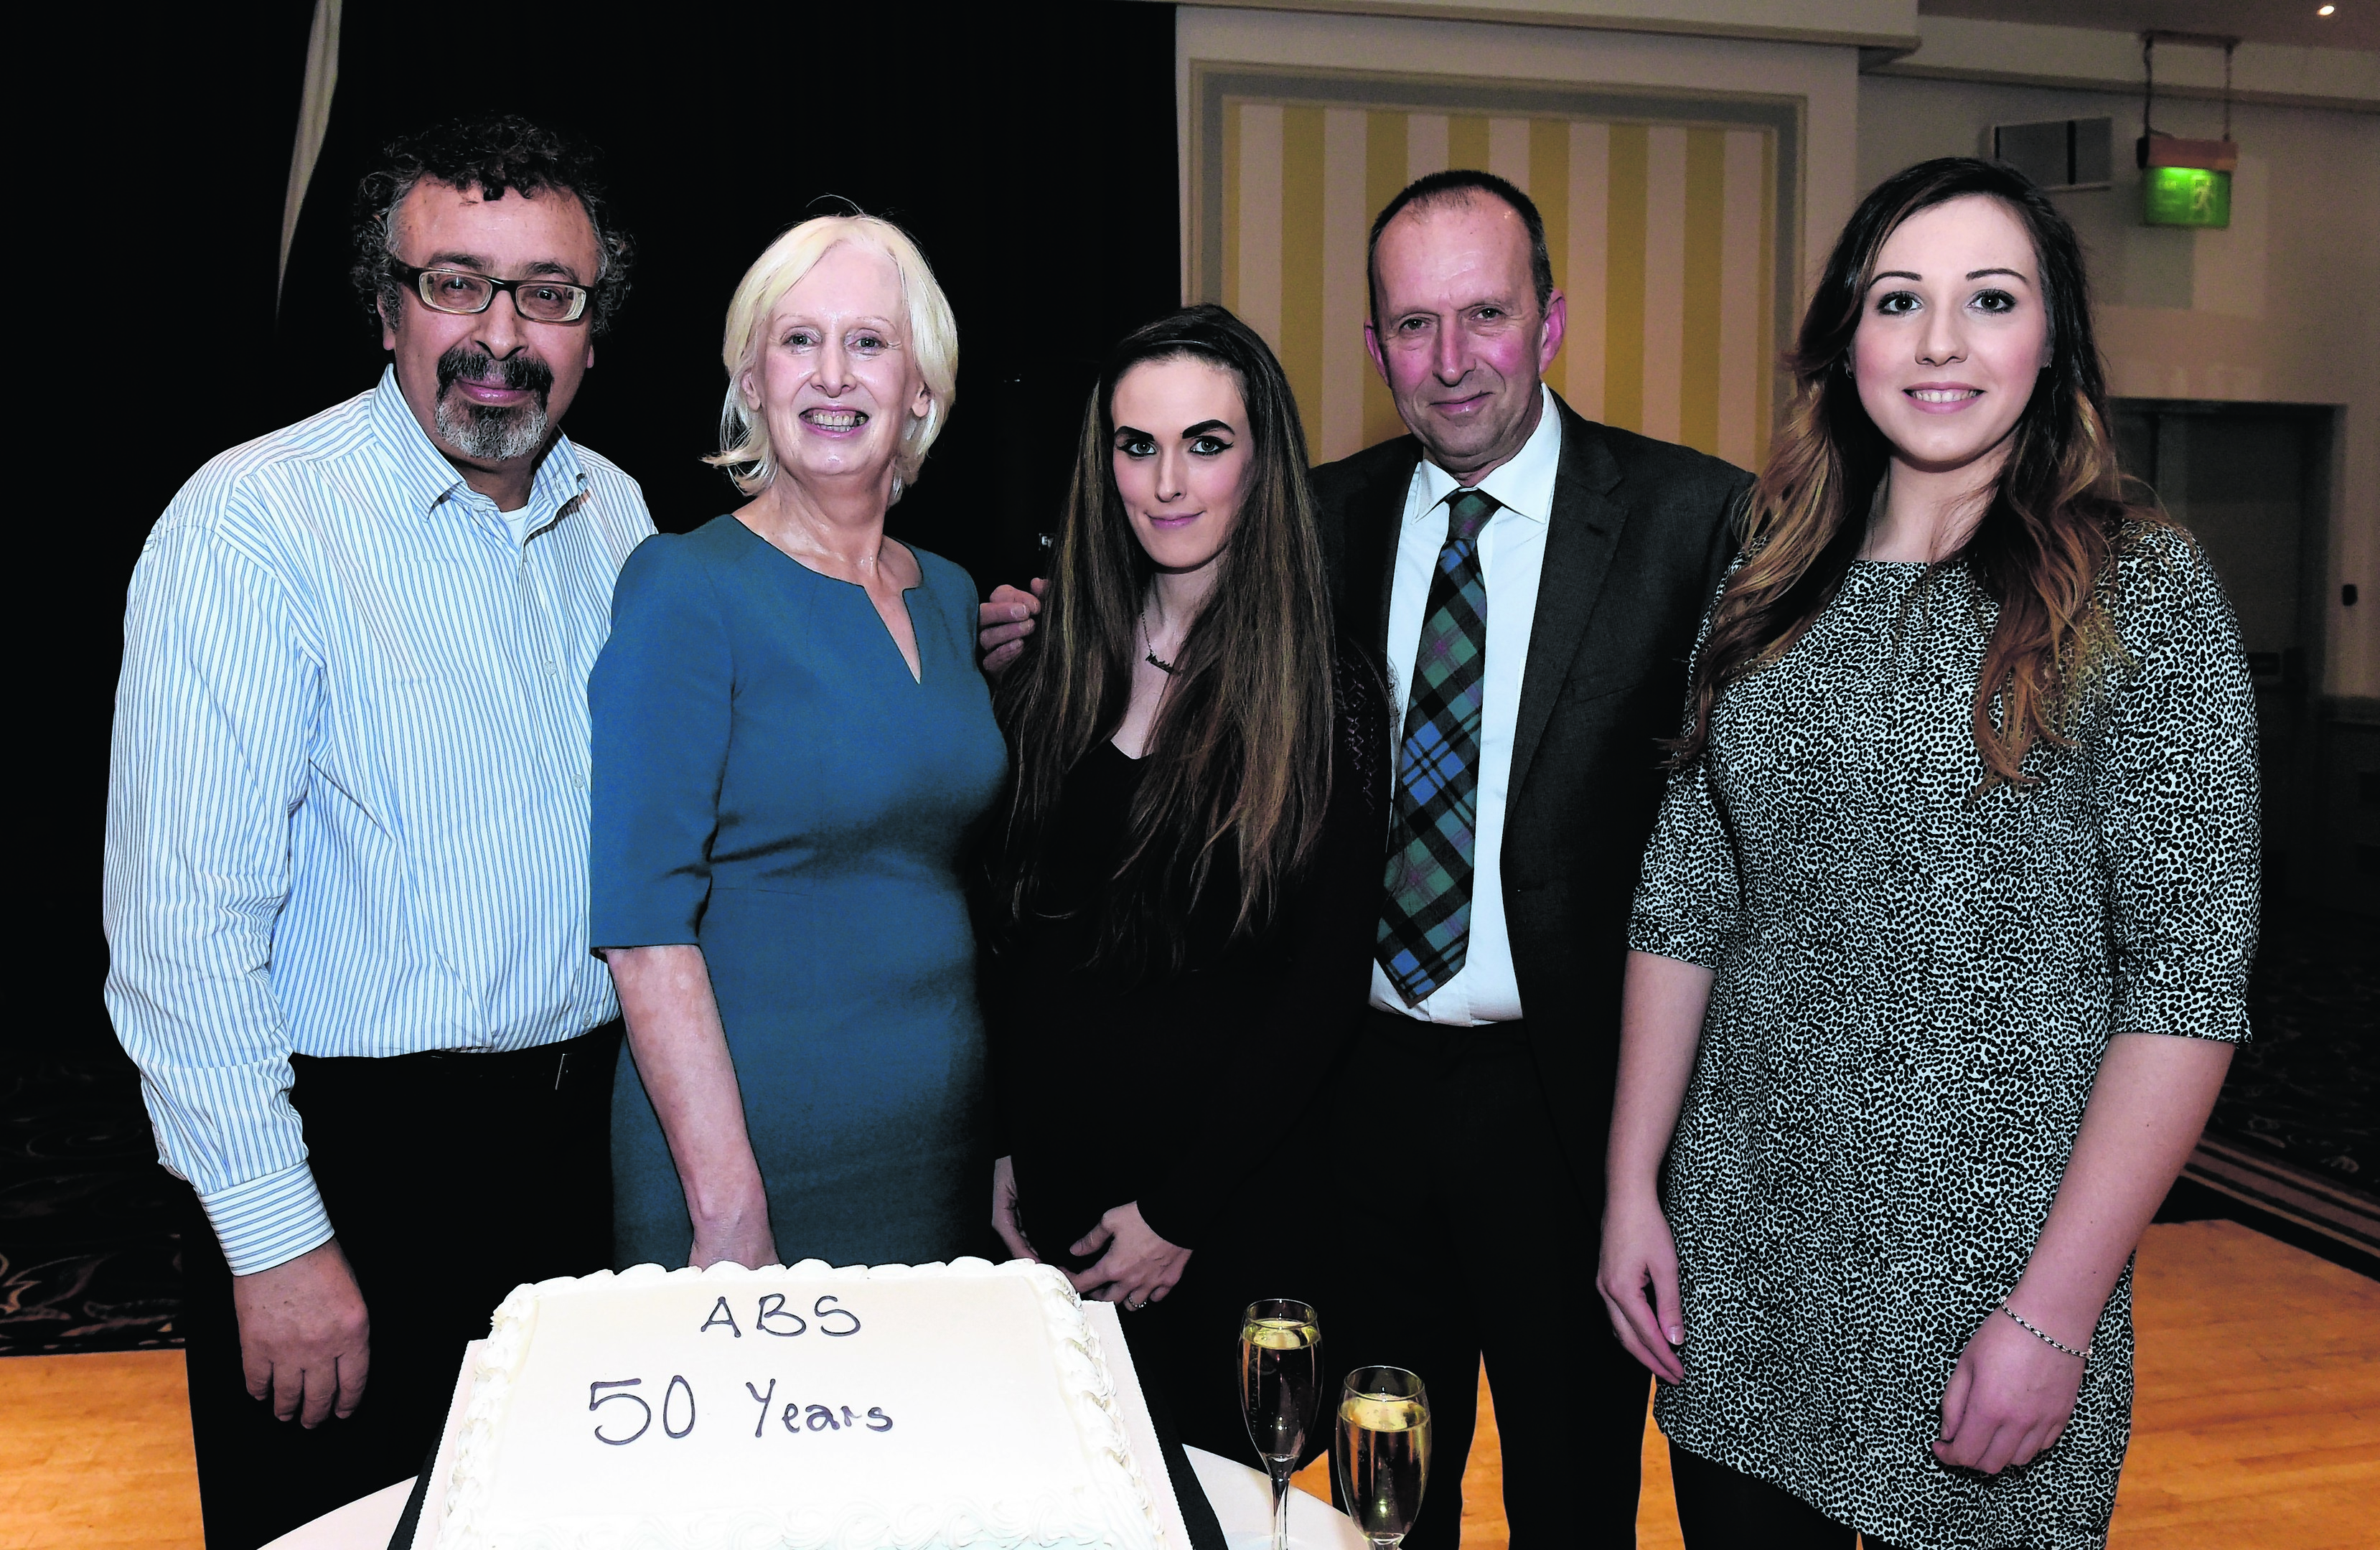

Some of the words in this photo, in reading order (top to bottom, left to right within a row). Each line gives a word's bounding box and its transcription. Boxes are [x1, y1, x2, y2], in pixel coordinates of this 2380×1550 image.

[701, 1293, 862, 1338] ABS
[589, 1375, 695, 1446] 50
[745, 1378, 894, 1438] Years
